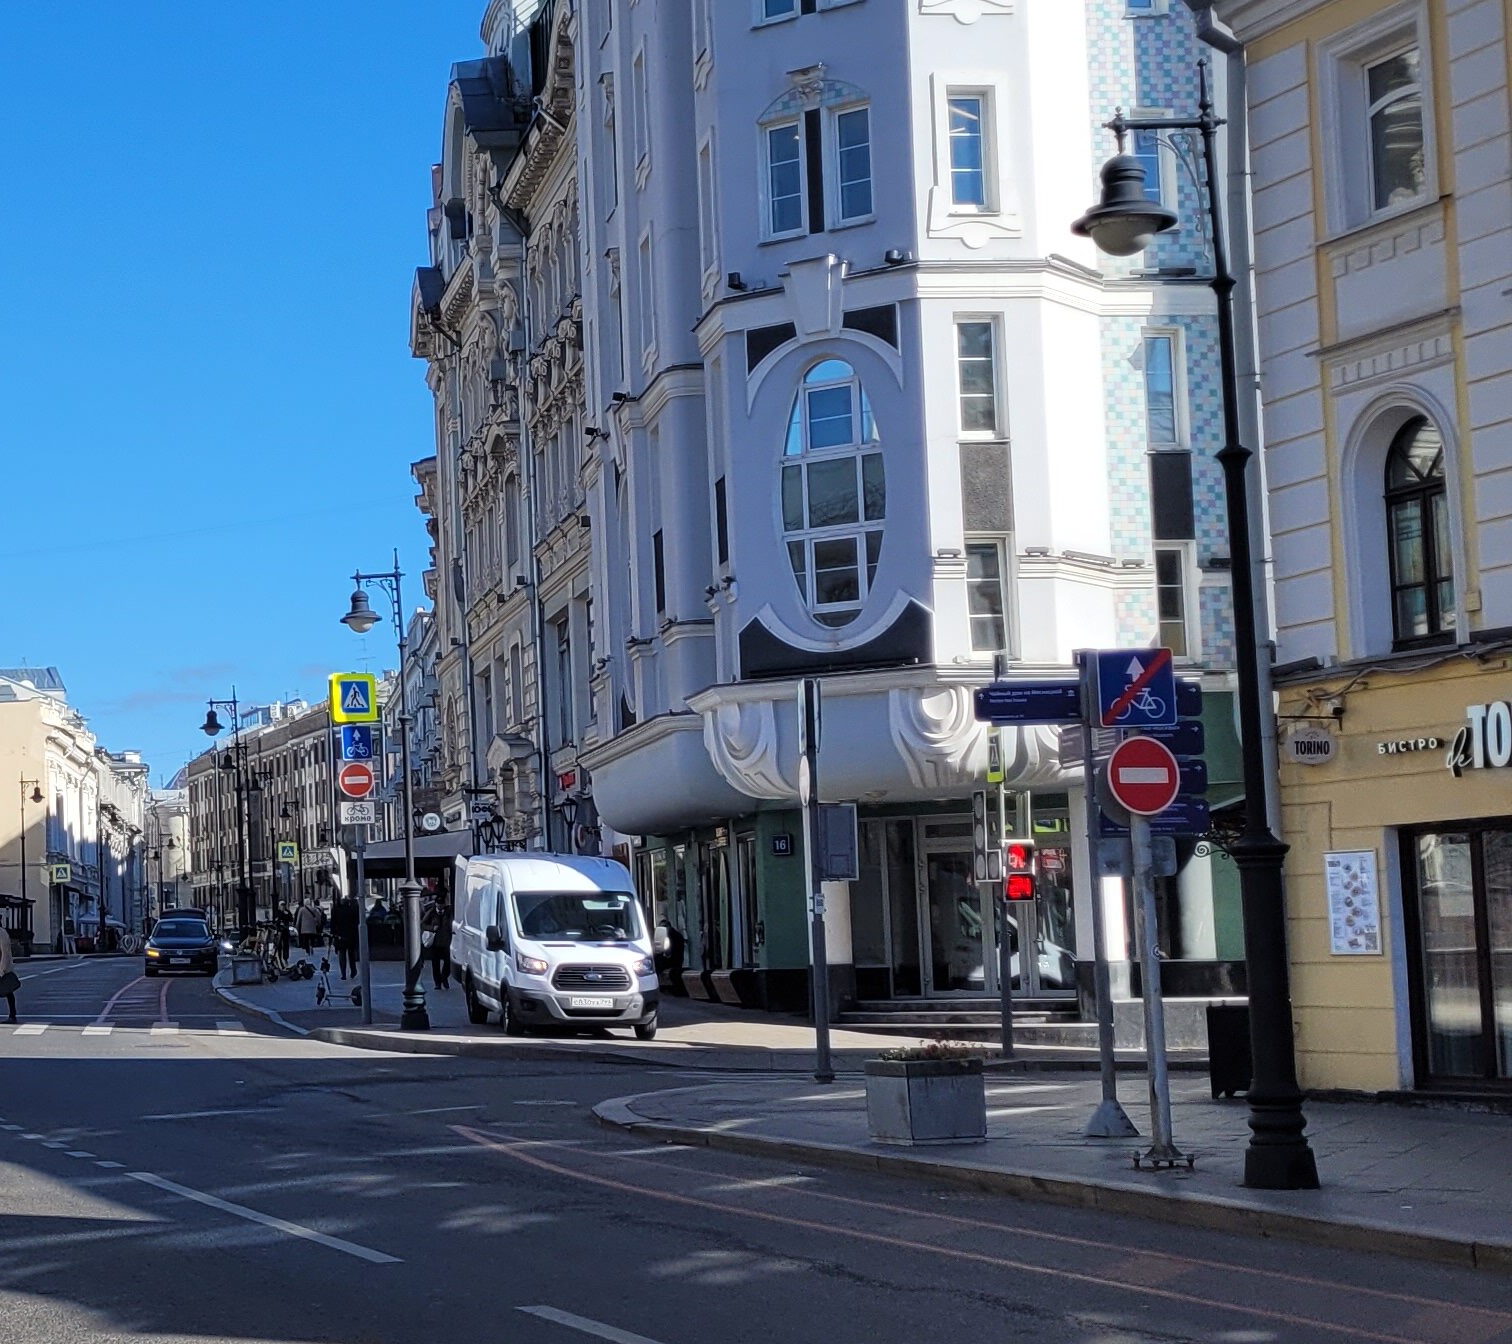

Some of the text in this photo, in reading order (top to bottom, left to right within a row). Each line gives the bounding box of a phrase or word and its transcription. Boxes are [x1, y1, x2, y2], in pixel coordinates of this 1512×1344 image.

[1294, 740, 1330, 755] TORINO
[1377, 737, 1438, 755] БИСТРО
[774, 839, 787, 850] 16
